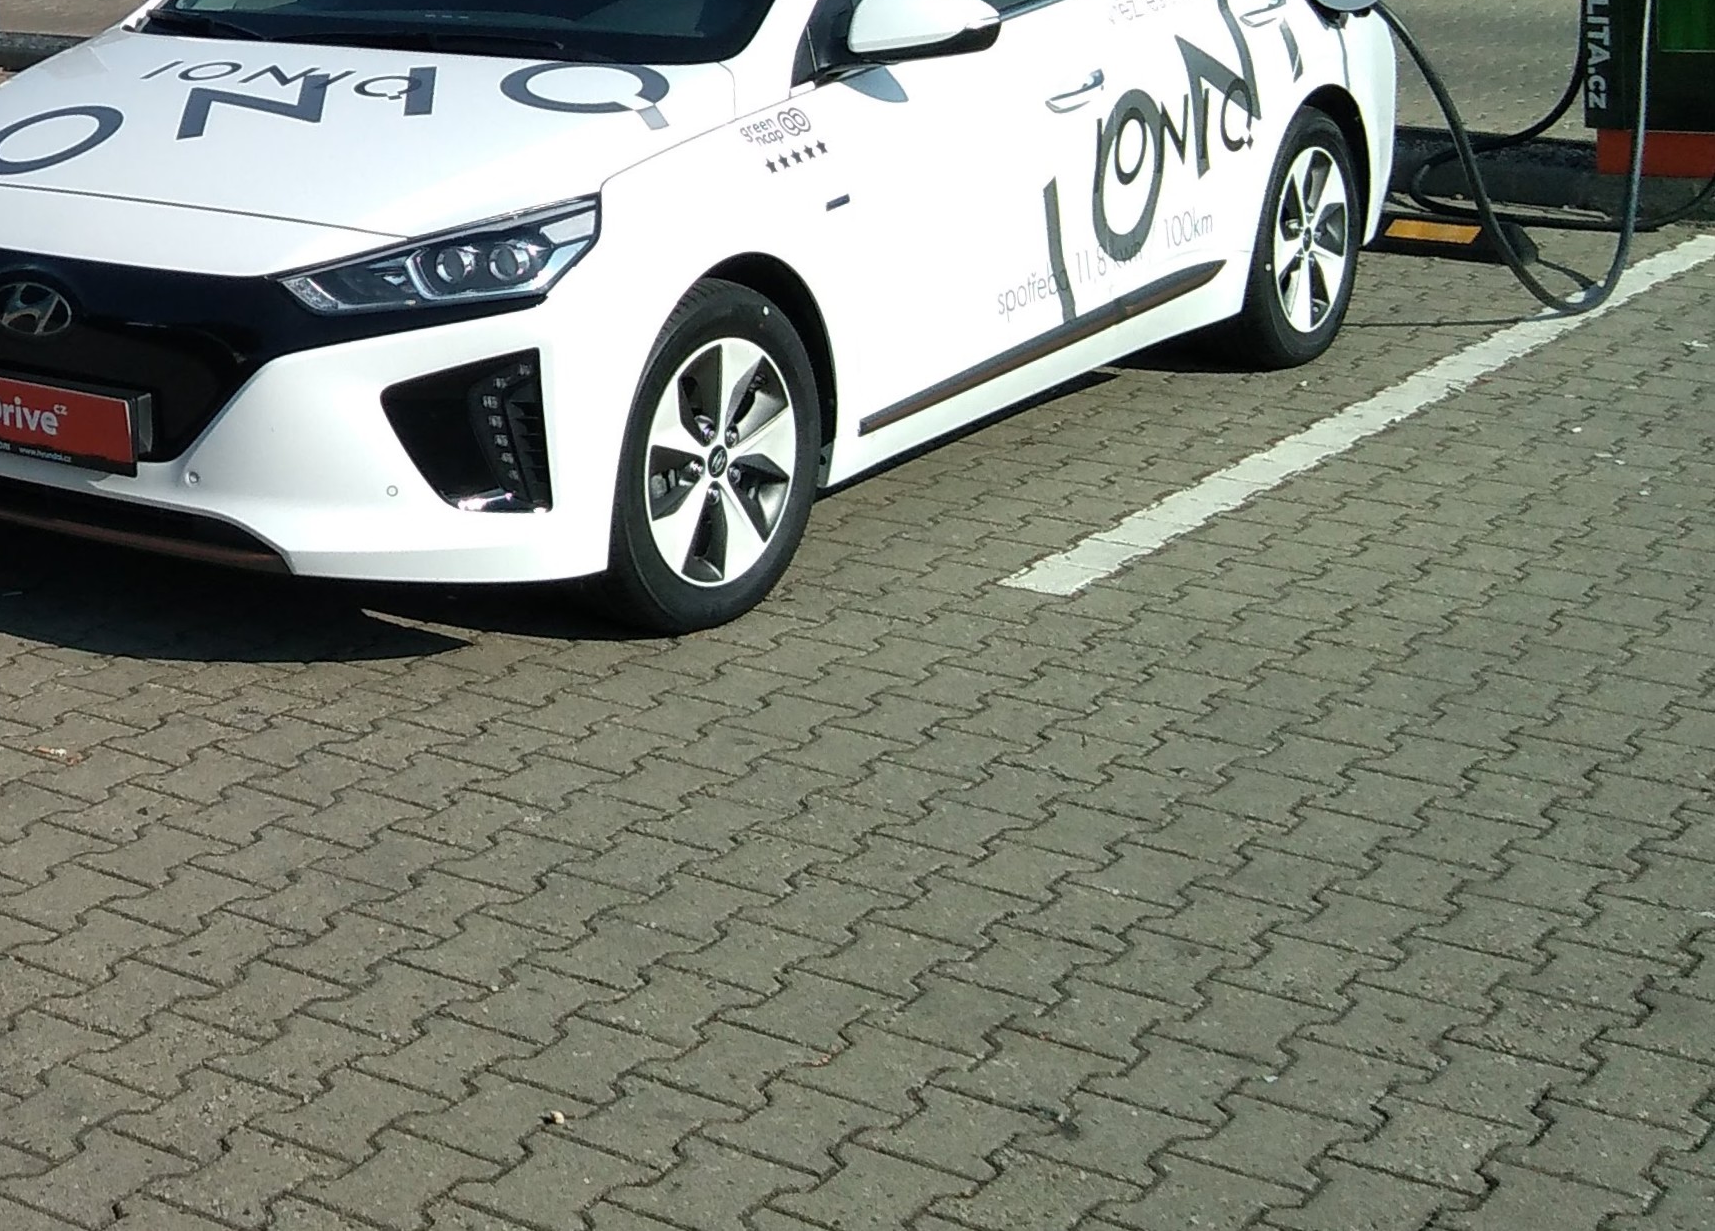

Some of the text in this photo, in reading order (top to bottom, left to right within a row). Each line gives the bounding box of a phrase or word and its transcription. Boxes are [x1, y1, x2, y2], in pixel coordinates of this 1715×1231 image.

[140, 60, 423, 101] IONIQ
[740, 118, 777, 143] green
[755, 129, 784, 147] ncap
[1164, 209, 1214, 249] 100km
